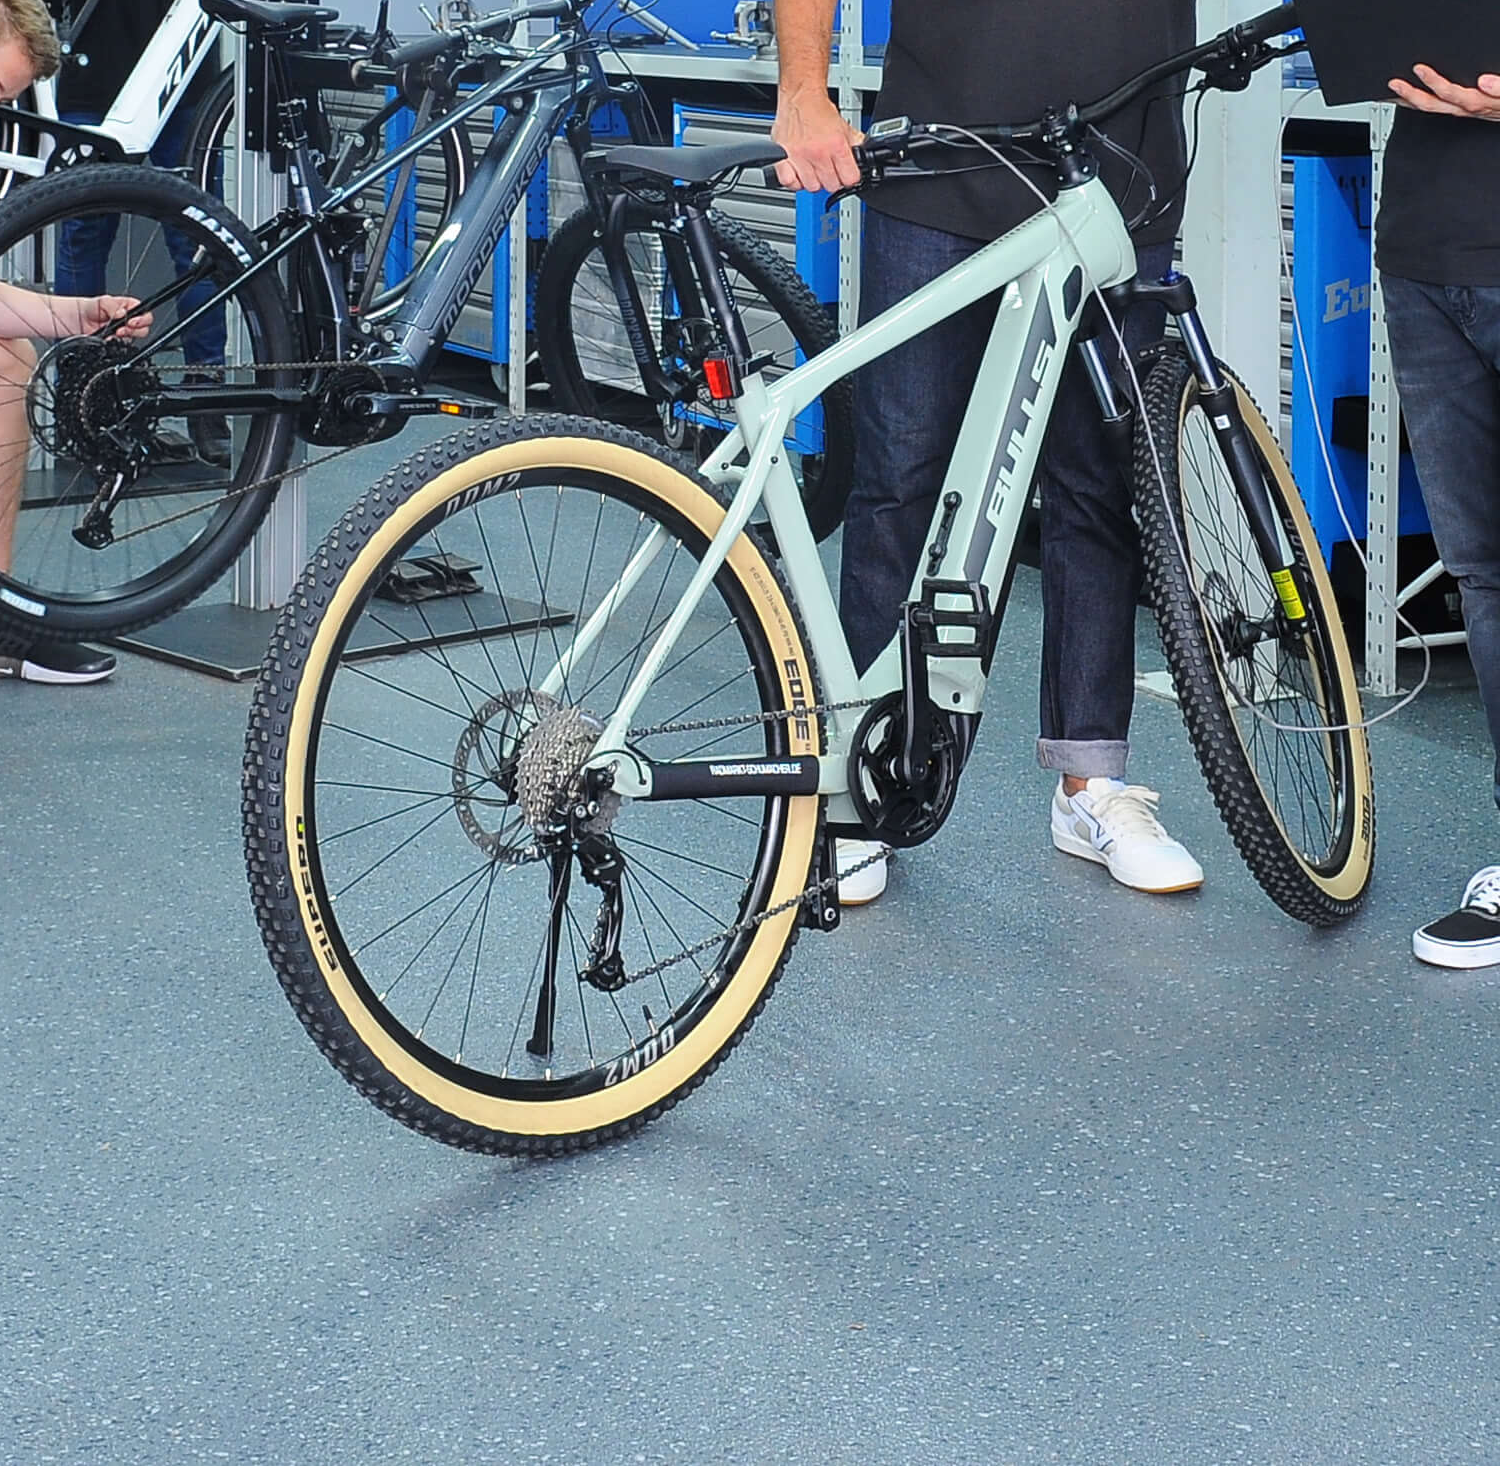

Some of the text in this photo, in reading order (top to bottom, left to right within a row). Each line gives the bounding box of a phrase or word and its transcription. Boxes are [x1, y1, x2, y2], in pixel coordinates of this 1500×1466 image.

[442, 131, 551, 335] MONDRAKER
[986, 338, 1055, 521] BULLS
[783, 659, 810, 741] EDGE
